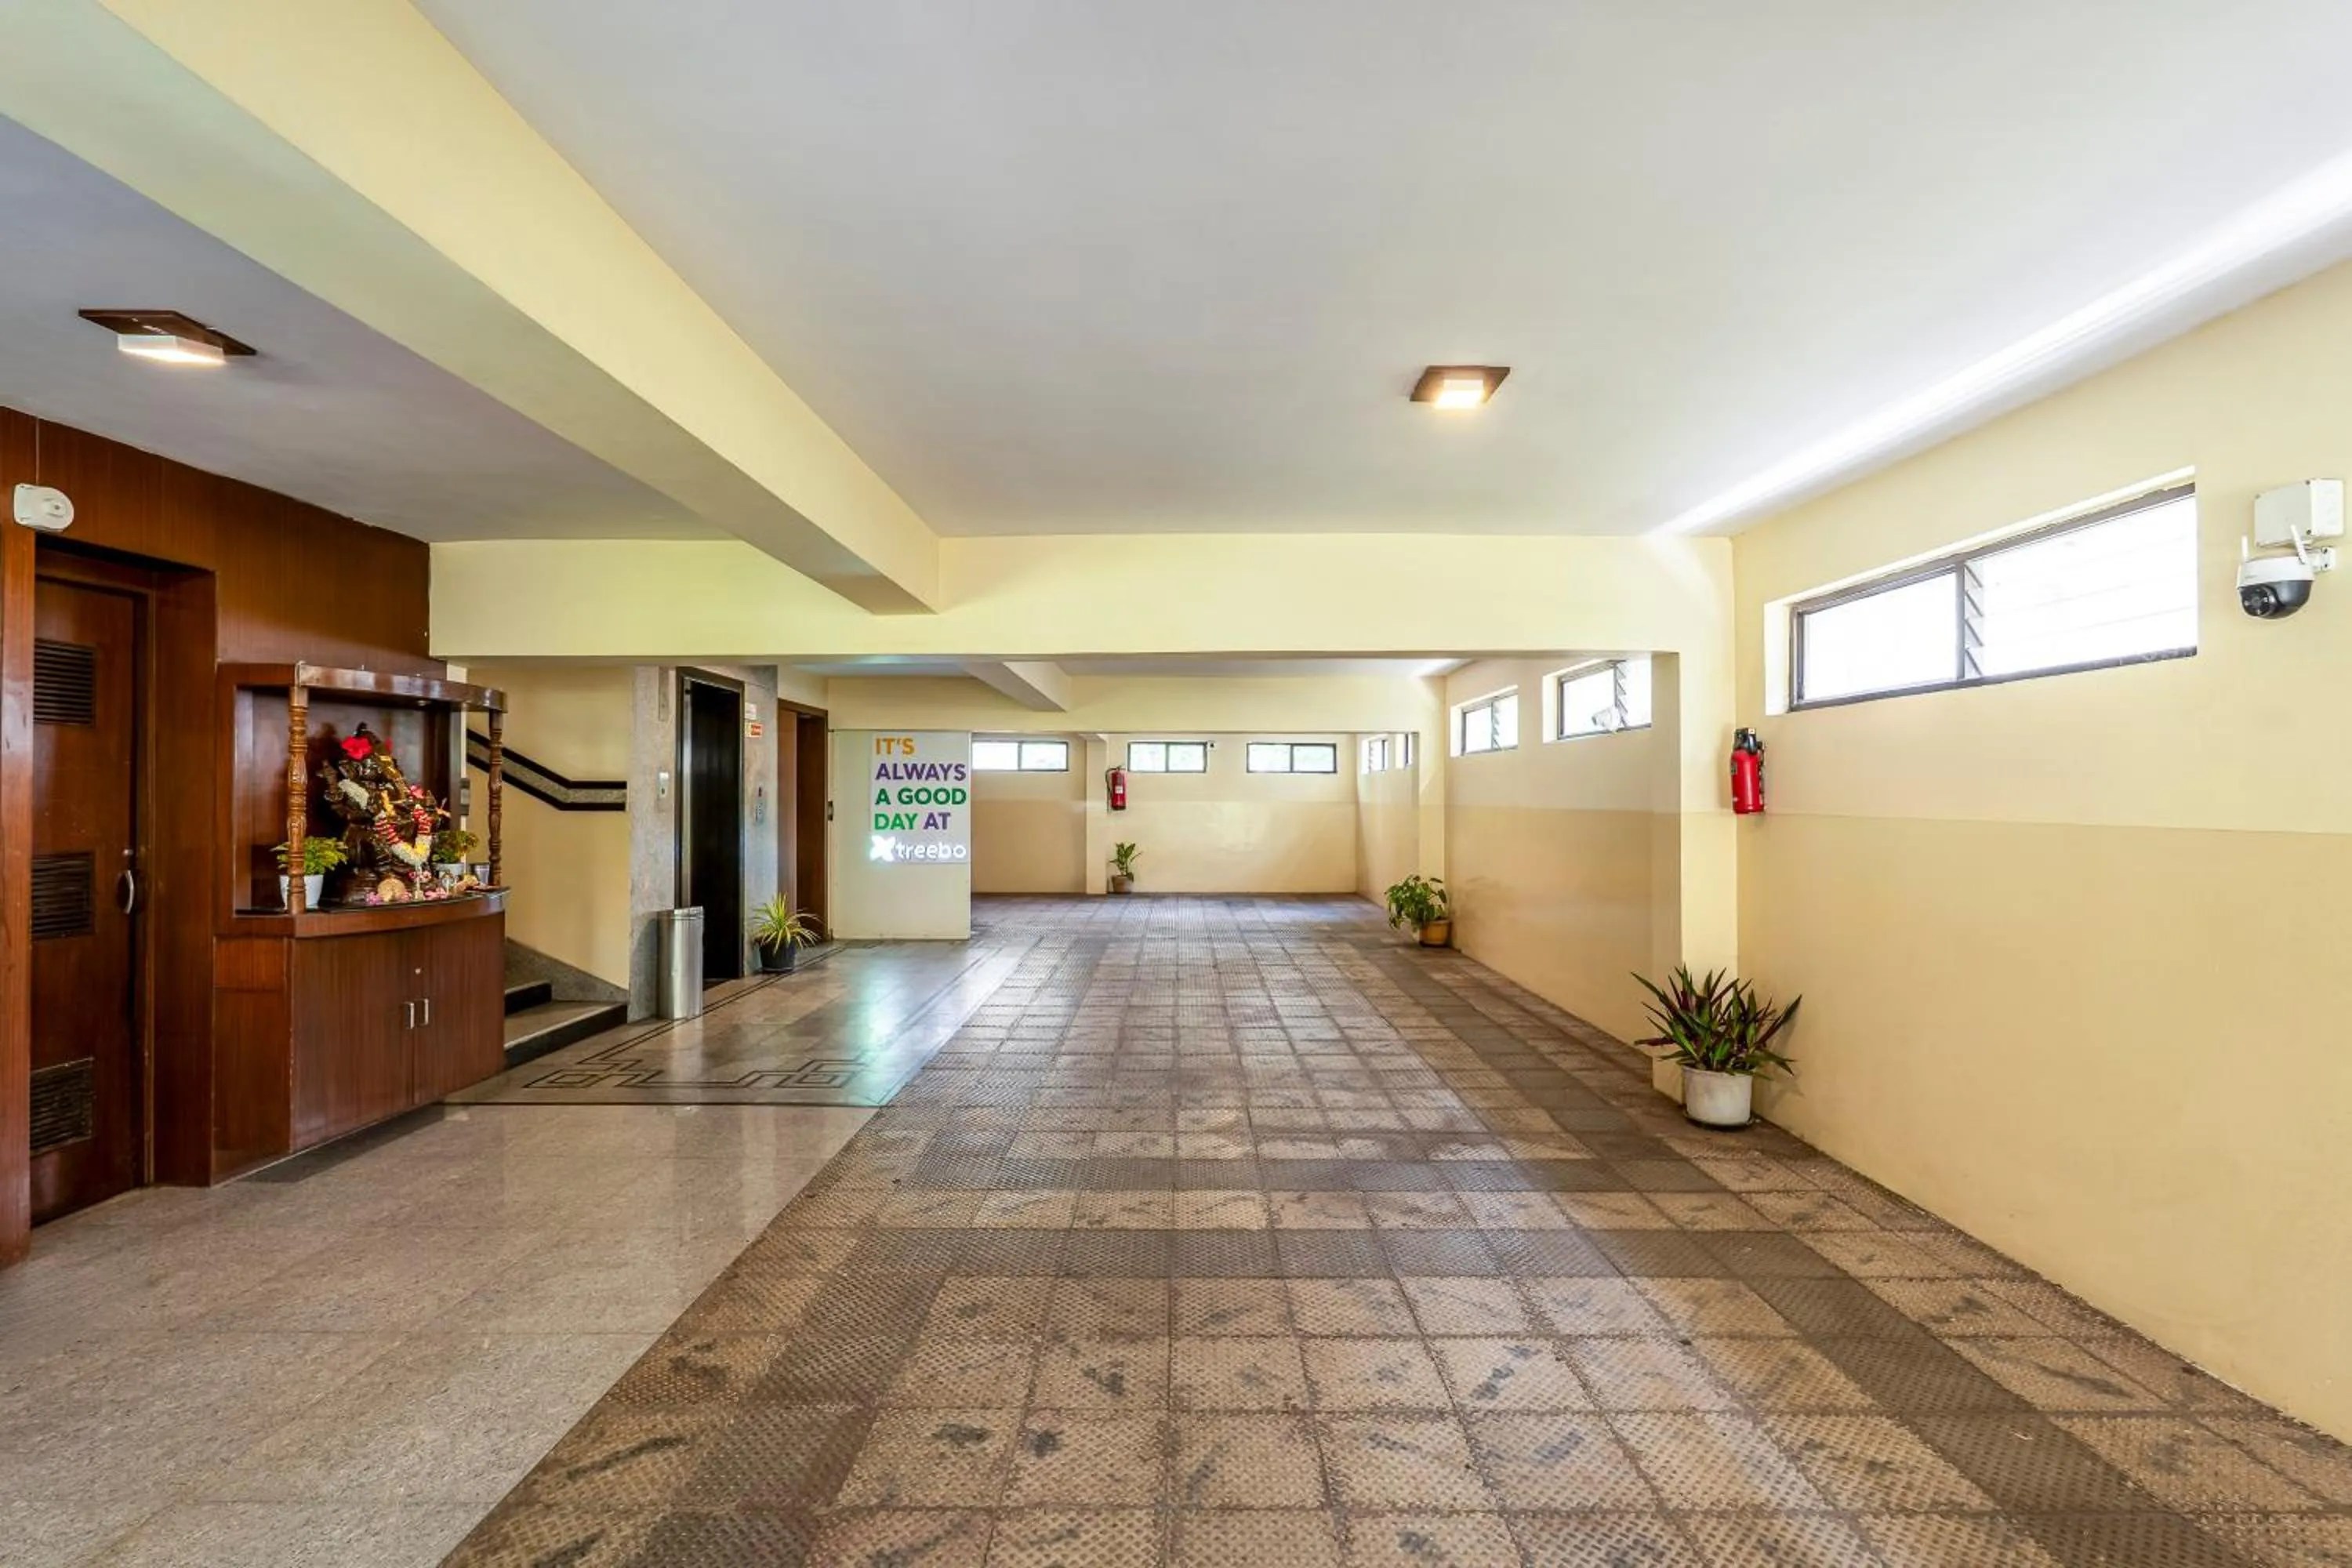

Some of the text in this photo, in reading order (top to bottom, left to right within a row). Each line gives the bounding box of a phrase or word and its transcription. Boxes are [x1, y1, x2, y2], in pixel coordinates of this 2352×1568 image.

[876, 738, 915, 755] IT'S
[875, 764, 967, 781] ALWAYS
[875, 788, 967, 805] A GOOD
[874, 812, 951, 830] DAY AT
[895, 841, 967, 860] treebo
